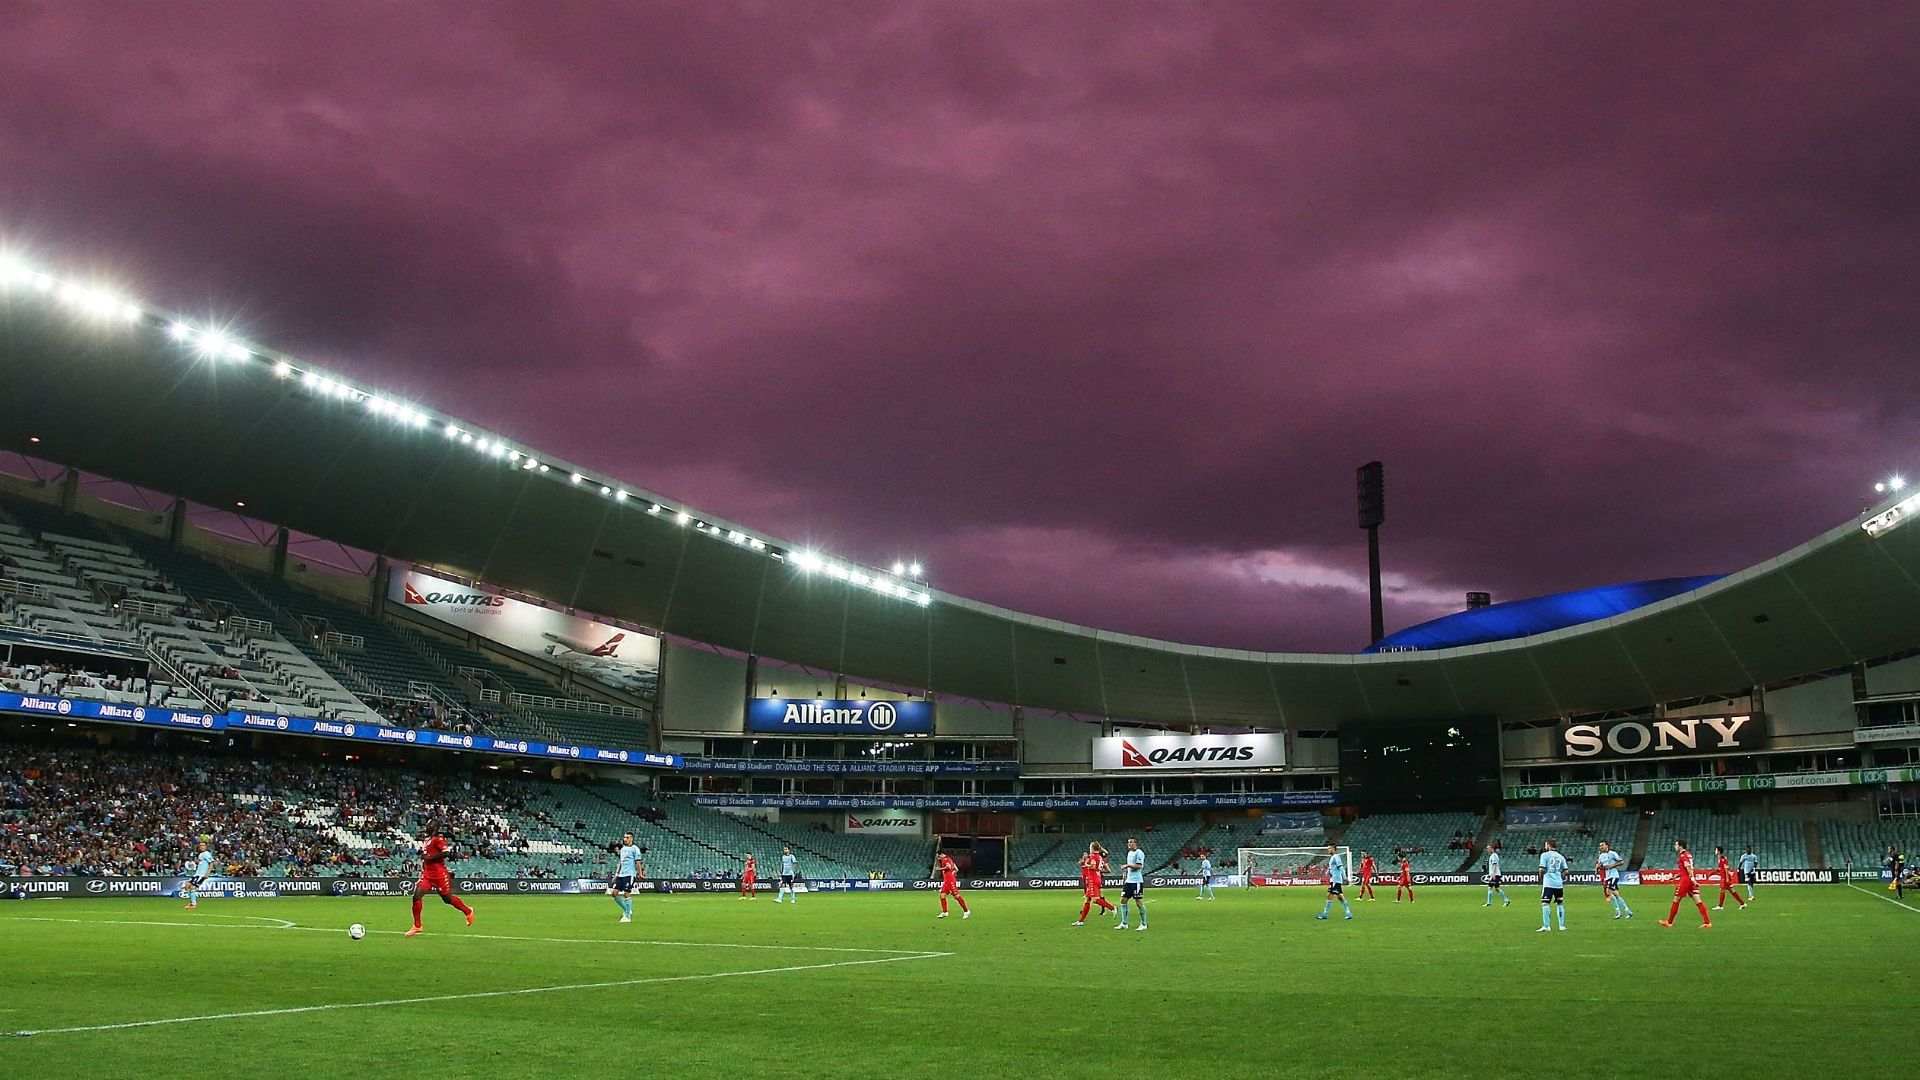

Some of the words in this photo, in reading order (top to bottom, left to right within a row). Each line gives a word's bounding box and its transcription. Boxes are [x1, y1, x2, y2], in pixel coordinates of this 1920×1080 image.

[425, 592, 505, 606] QANTAS
[20, 697, 57, 711] Allianz
[100, 704, 132, 718] Allianz
[783, 704, 863, 725] Allianz
[171, 712, 202, 724] Allianz
[244, 714, 276, 727] Allianz
[314, 721, 343, 734] Allianz
[378, 728, 405, 740] Allianz
[438, 734, 462, 744] Allianz
[1565, 716, 1750, 756] SONY
[493, 740, 518, 750] Allianz
[547, 745, 570, 755] Allianz
[598, 750, 619, 760] Allianz
[644, 754, 666, 764] Allianz
[1149, 746, 1254, 763] QANTAS
[714, 762, 736, 770] Allianz
[746, 762, 772, 770] Stadium
[776, 764, 810, 772] DOWNLOAD
[813, 764, 824, 772] THE
[850, 764, 876, 772] ALLIANZ
[1704, 779, 1724, 790] IOOF
[1752, 777, 1773, 788] IOOF
[1787, 776, 1838, 786] ioof.com.au
[1520, 786, 1538, 798] IOOF
[1564, 786, 1583, 796] IOOF
[1610, 784, 1630, 795] IOOF
[1657, 782, 1677, 792] IOOF
[696, 797, 718, 805] Allianz
[762, 798, 784, 806] Allianz
[862, 818, 917, 827] QANTAS
[1549, 858, 1561, 870] 23
[1265, 878, 1291, 886] Harvey
[1569, 874, 1600, 882] HYUND
[110, 882, 162, 891] HYUNDAI
[278, 882, 320, 890] HYUNDAI
[350, 882, 388, 890] HYUNDAI
[474, 882, 508, 890] HYUNDAI
[580, 882, 608, 890] HYUNDAI
[985, 880, 1019, 888] HYUNDAI
